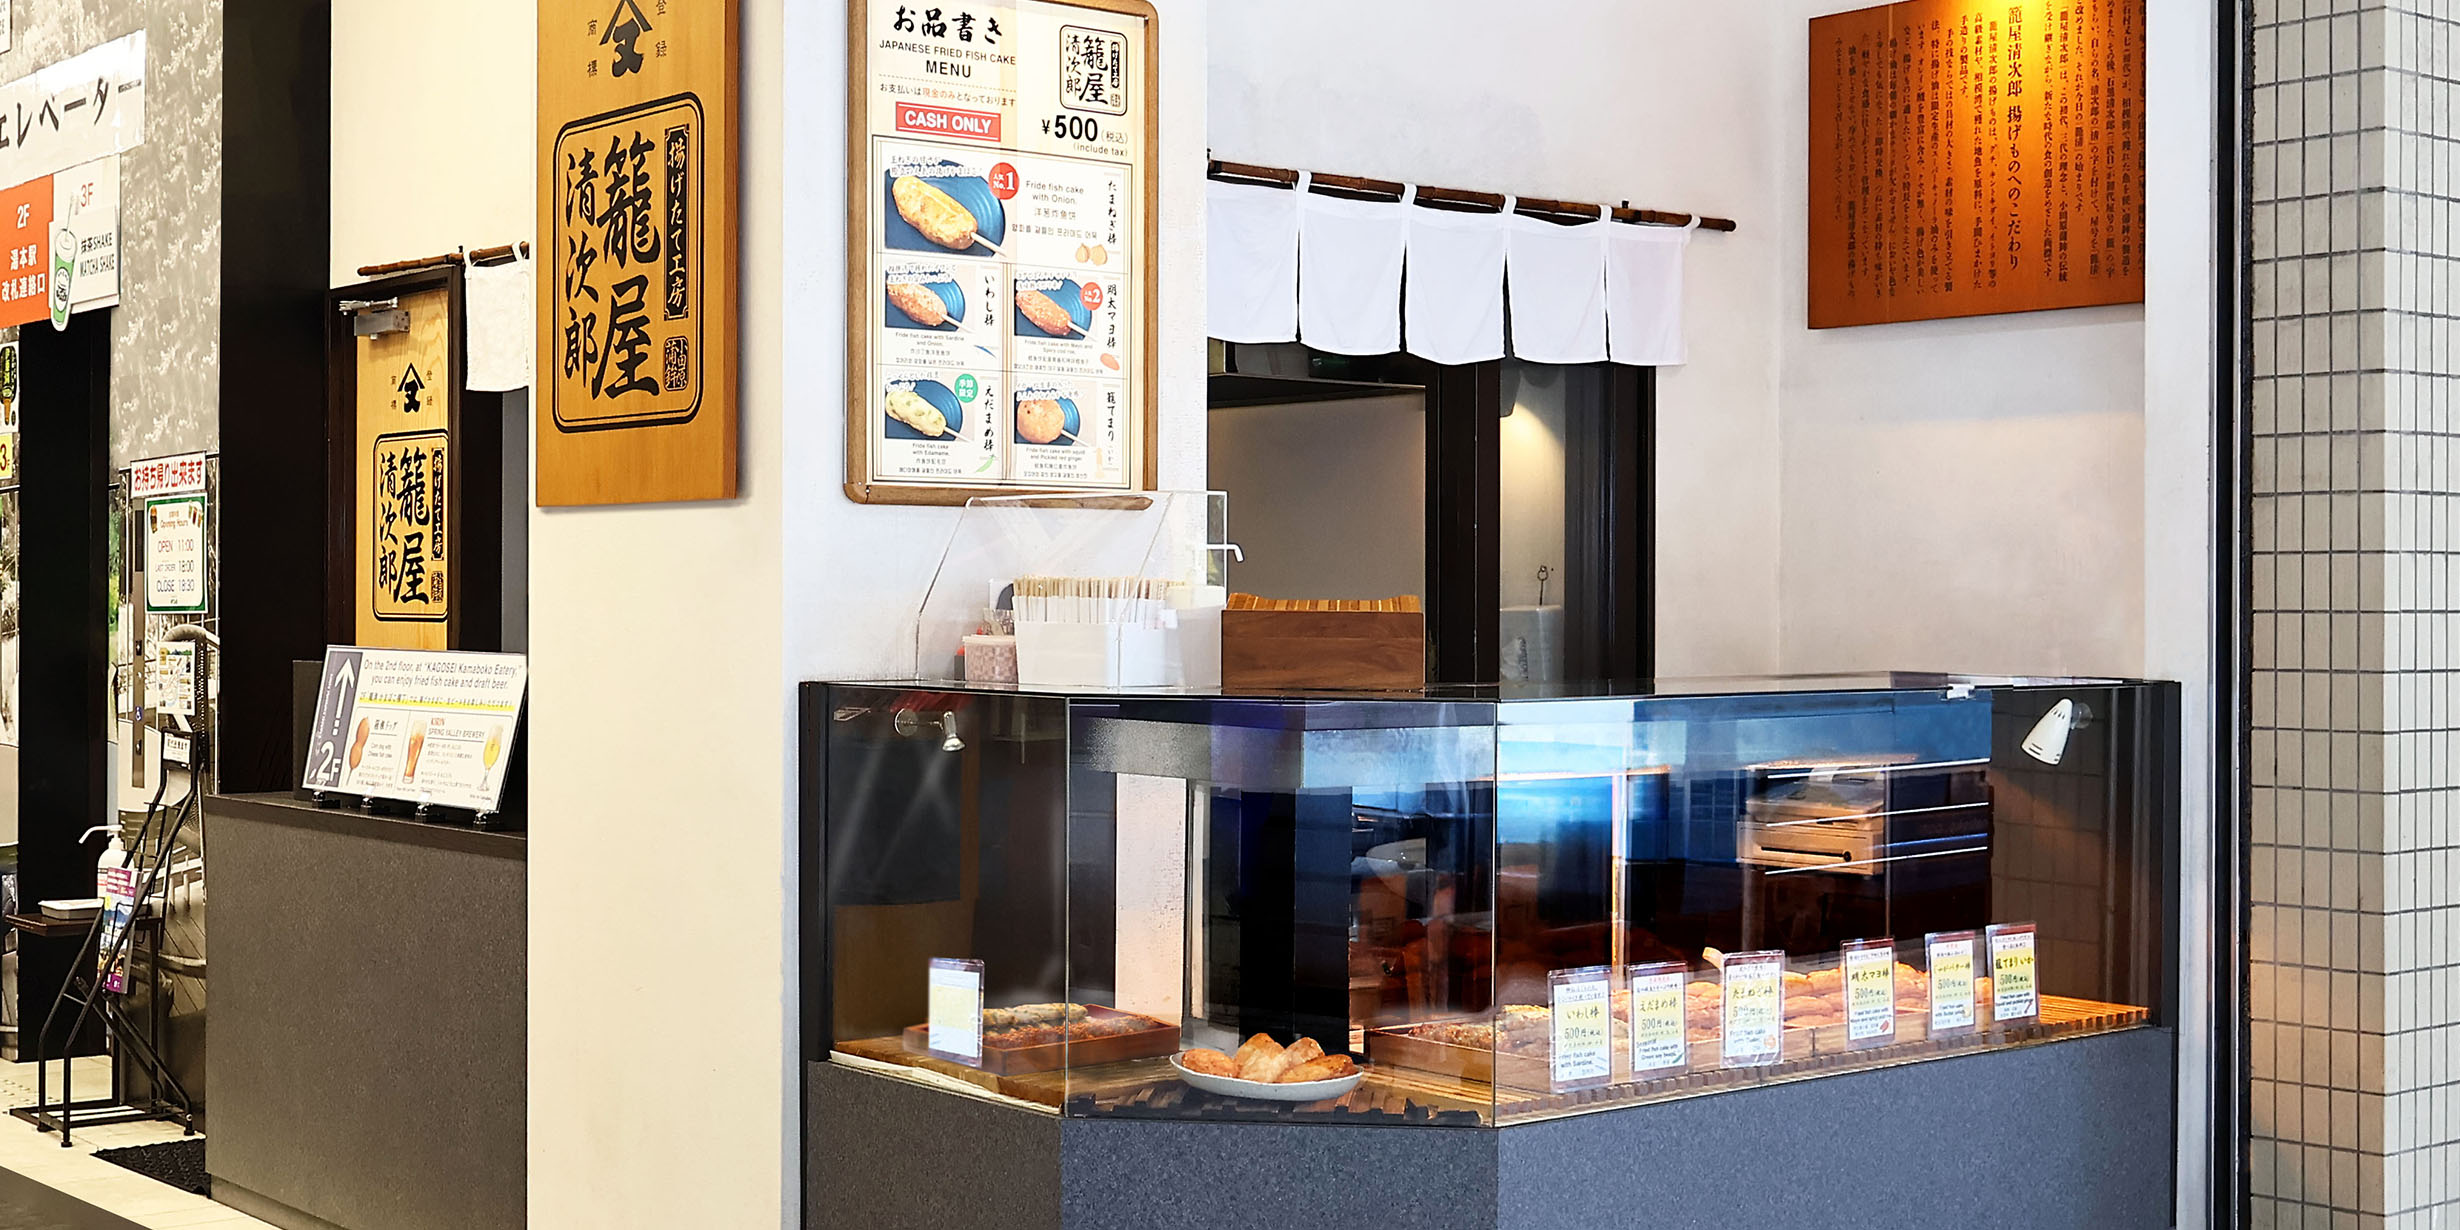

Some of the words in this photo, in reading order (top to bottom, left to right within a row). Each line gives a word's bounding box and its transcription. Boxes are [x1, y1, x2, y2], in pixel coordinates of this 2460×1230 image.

[893, 5, 1002, 45] お品書き
[879, 39, 931, 55] JAPANESE
[934, 46, 963, 59] FRIED
[965, 50, 988, 62] FISH
[989, 52, 1016, 65] CAKE
[1066, 34, 1081, 97] 清次郎
[2007, 5, 2022, 97] 籠屋清次郎
[925, 60, 972, 78] MENU
[1079, 35, 1109, 105] 籠屋
[880, 83, 1016, 107] お支払いは現金のみとなっております
[904, 110, 948, 129] CASH
[951, 115, 992, 134] ONLY
[1073, 142, 1109, 155] (include
[1111, 147, 1128, 157] tax)
[80, 183, 94, 207] 3F
[1026, 180, 1046, 190] Fride
[1048, 182, 1063, 193] fish
[1066, 185, 1084, 194] cake
[1032, 193, 1049, 202] with
[2007, 105, 2022, 272] 揚げものへのこだわり
[17, 204, 30, 229] 2F
[667, 137, 687, 308] 揚げたて工房
[1107, 180, 1117, 244] たまねぎ棒
[10, 244, 37, 271] 湯本駅
[564, 148, 599, 388] 清次郎
[592, 131, 660, 401] 籠屋
[1, 273, 46, 302] 改札連絡口
[984, 275, 995, 326] いわし棒
[1107, 284, 1117, 349] 明太マヨ棒
[984, 385, 994, 452] えだまめ棒
[134, 460, 203, 491] お持ち帰り出来ます
[379, 451, 398, 595] 清次郎
[395, 447, 430, 605] 籠屋
[157, 540, 173, 553] OPEN
[177, 539, 194, 552] 11:00
[156, 579, 175, 592] CLOSE
[364, 659, 373, 670] On
[374, 660, 384, 671] the
[385, 661, 397, 671] 2nd
[399, 661, 414, 673] floor,
[415, 663, 423, 672] at
[458, 663, 492, 675] Kamaboko
[371, 675, 382, 685] you
[383, 676, 395, 684] can
[396, 675, 412, 688] enjoy
[414, 675, 429, 686] fried
[430, 676, 442, 686] fish
[443, 677, 459, 687] cake
[460, 677, 473, 688] and
[474, 677, 490, 689] draft
[491, 678, 508, 690] beer.
[315, 741, 341, 782] 2F
[1640, 997, 1677, 1012] えだまめ棒
